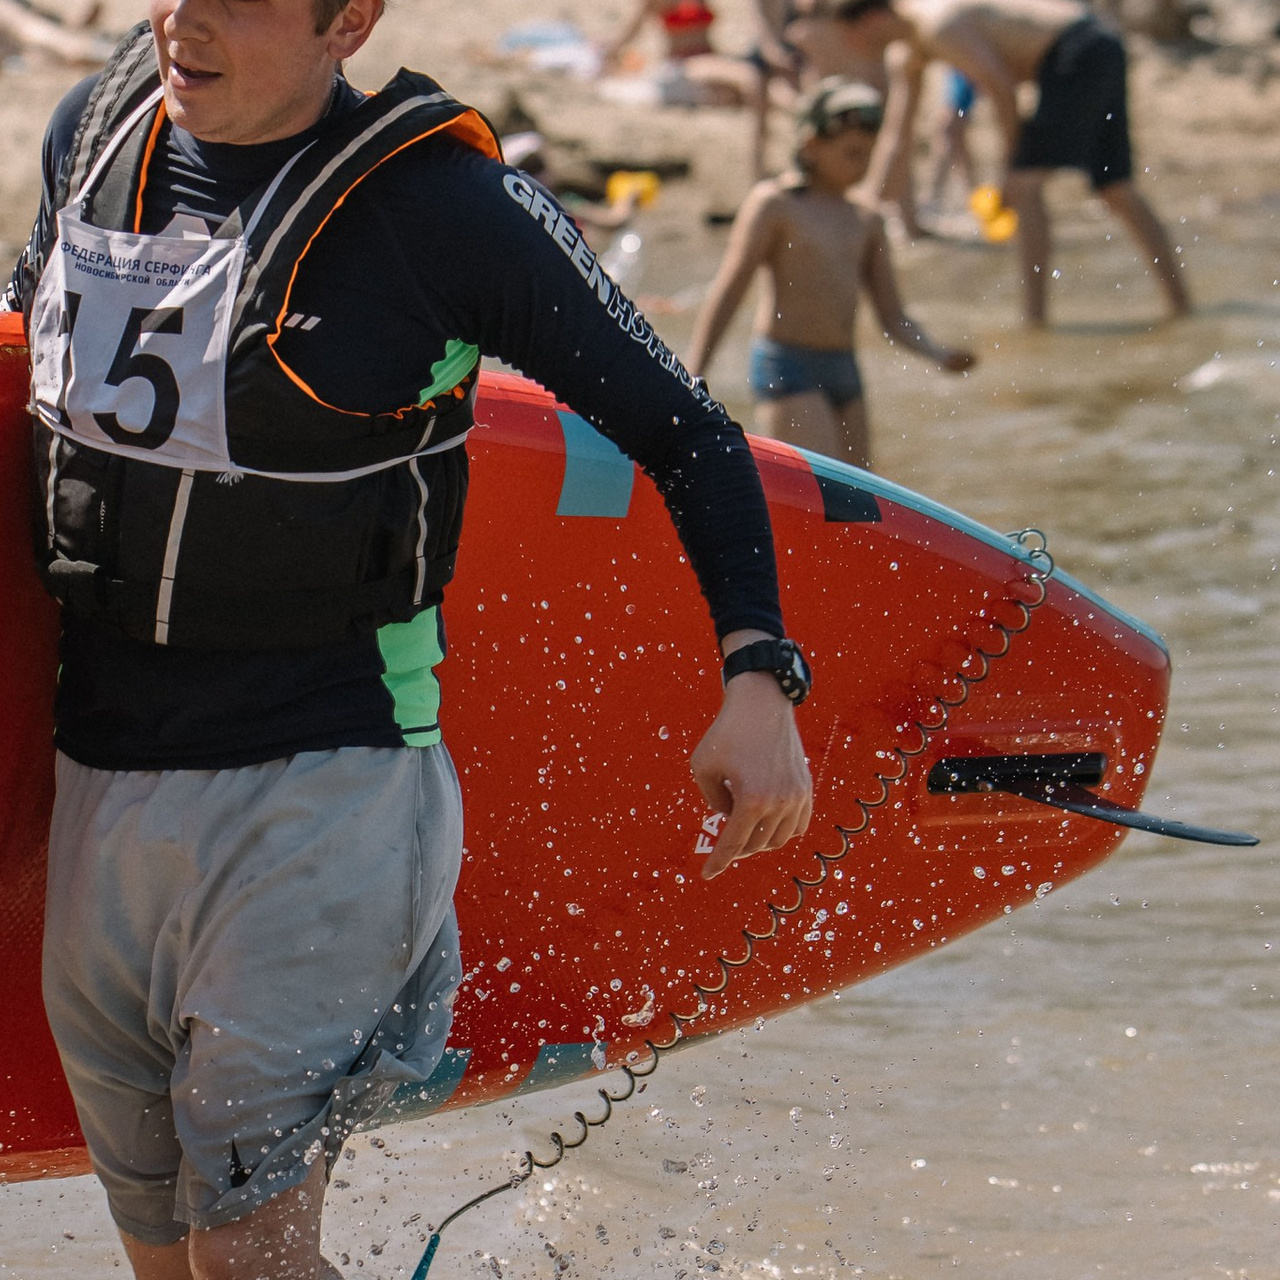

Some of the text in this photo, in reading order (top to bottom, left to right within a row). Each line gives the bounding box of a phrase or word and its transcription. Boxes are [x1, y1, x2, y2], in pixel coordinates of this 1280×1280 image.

[61, 241, 212, 277] ФЕДЕРАЦИЯ СЕРФИНГА
[75, 262, 150, 285] НОВОСИБИРСКОЙ
